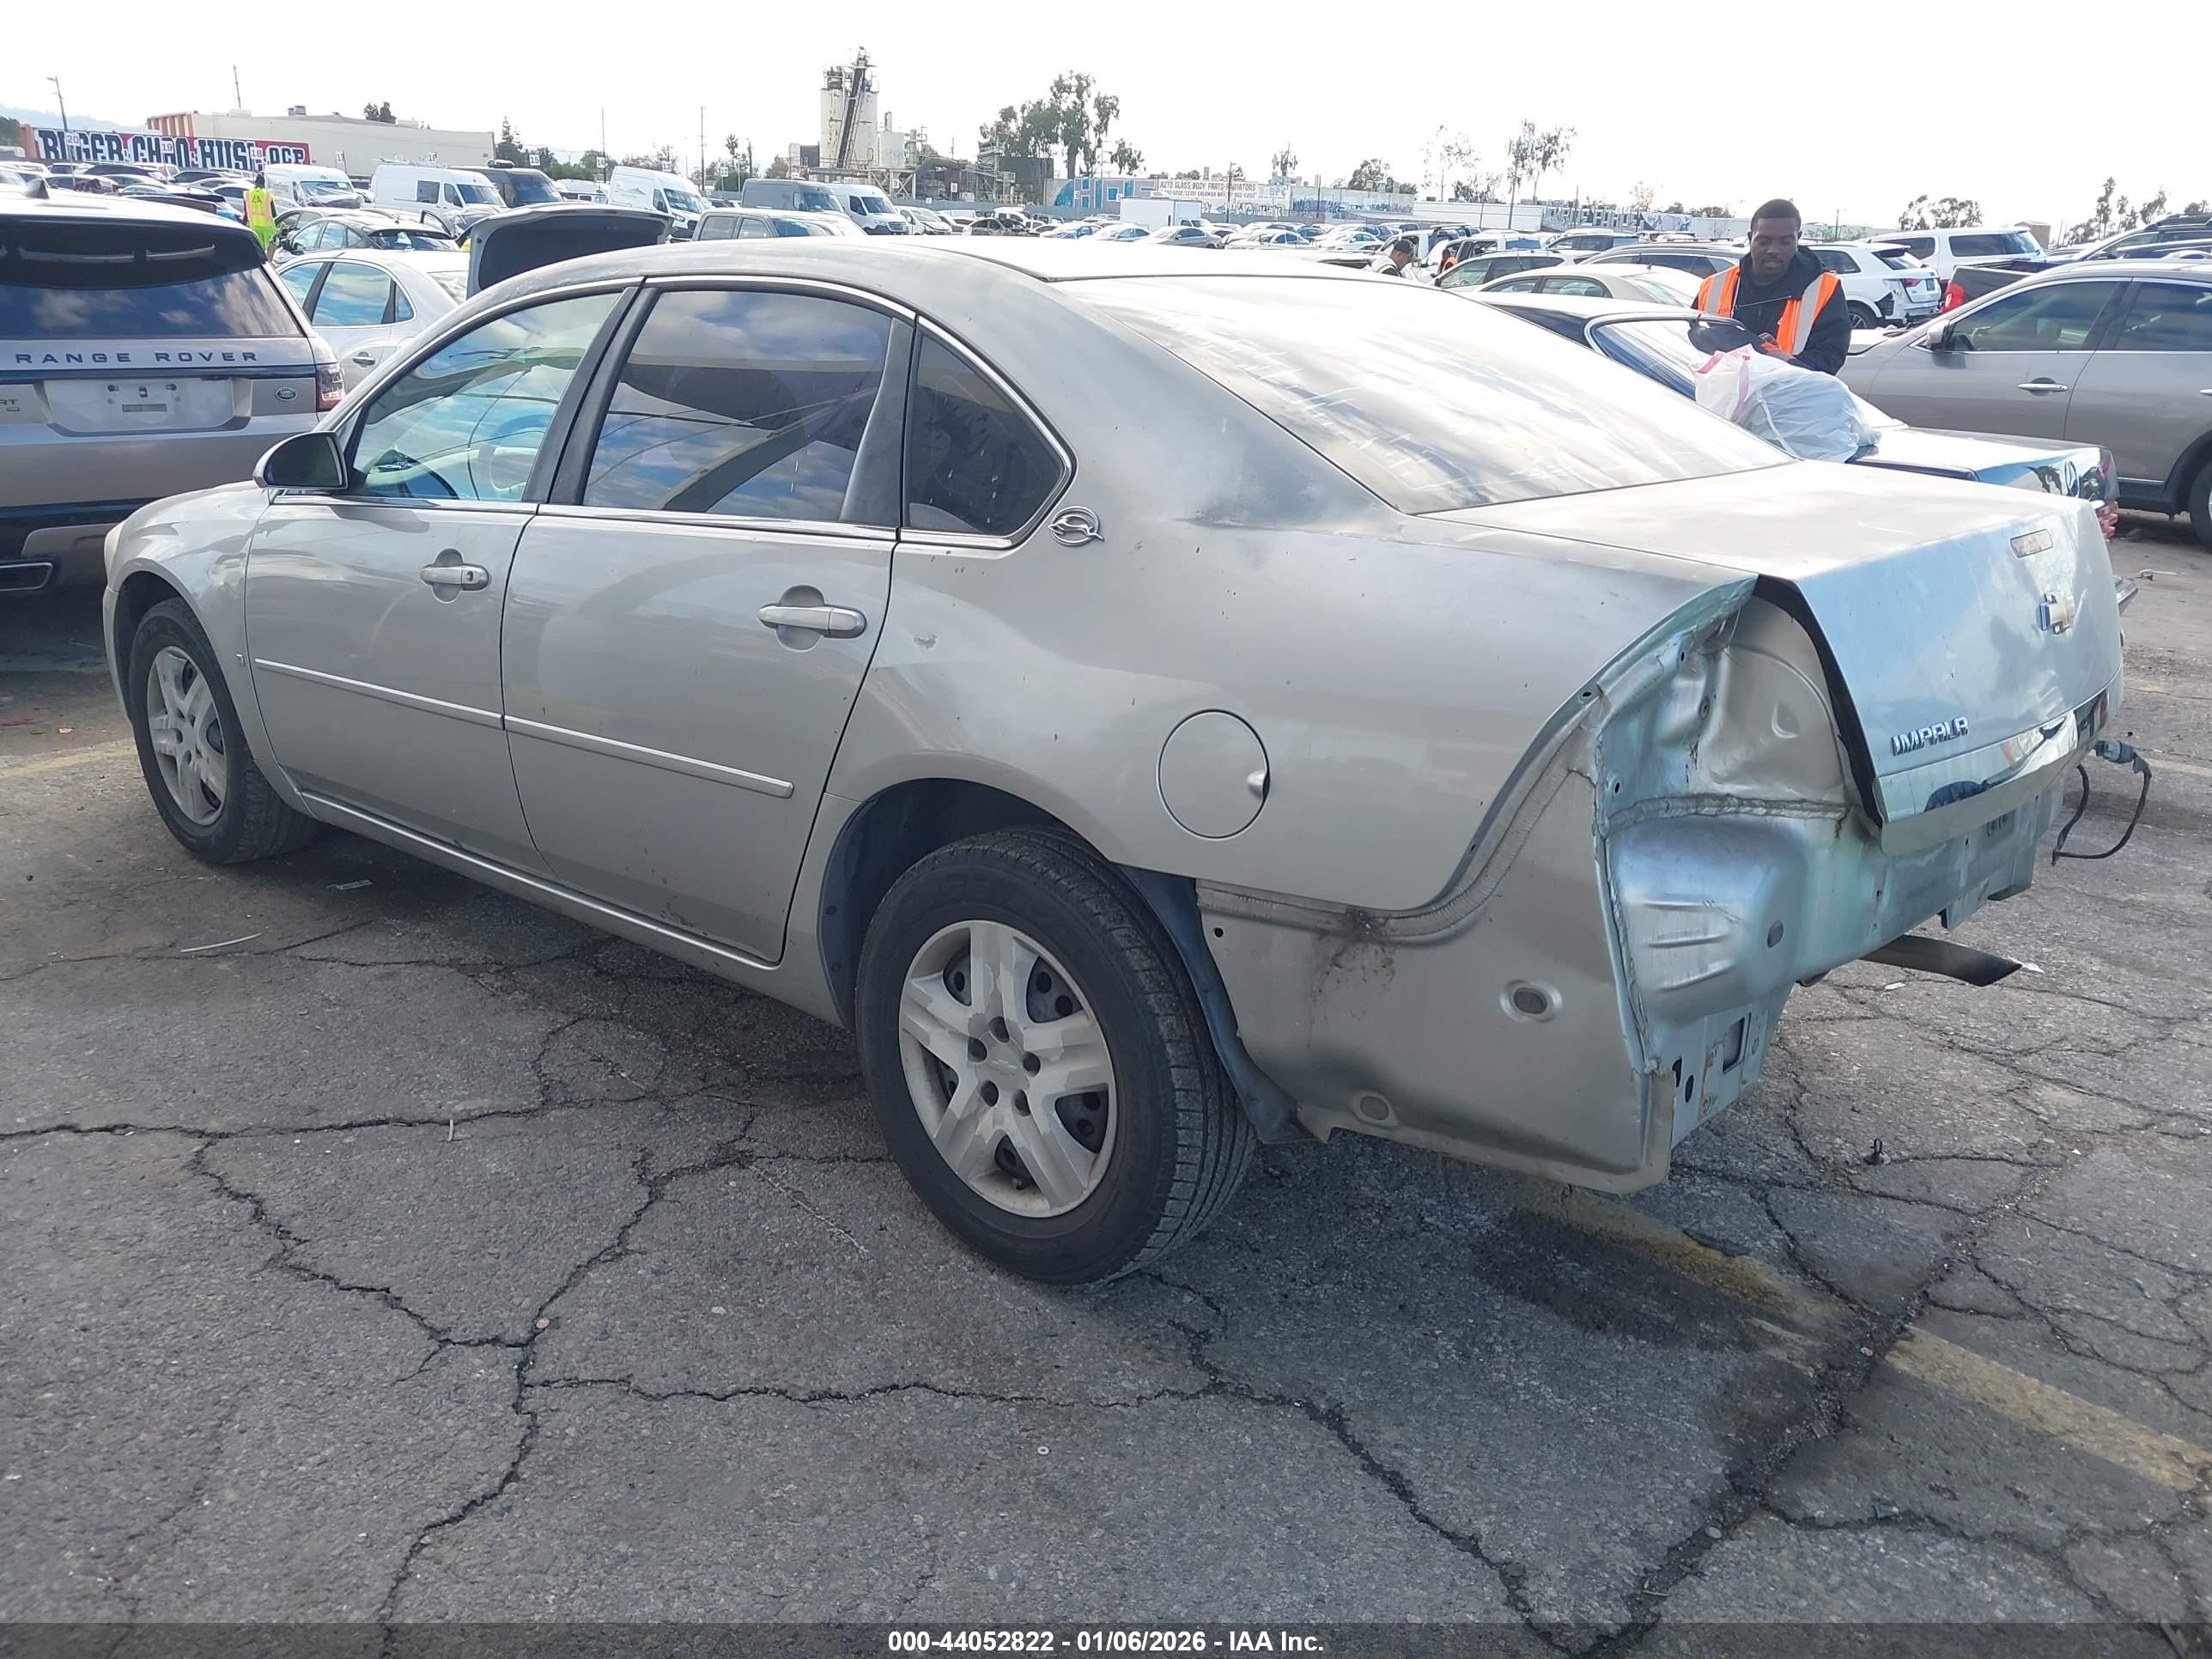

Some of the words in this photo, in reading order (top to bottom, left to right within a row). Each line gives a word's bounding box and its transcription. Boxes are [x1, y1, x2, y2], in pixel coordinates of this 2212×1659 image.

[67, 135, 79, 144] 20
[15, 352, 131, 364] RANGE
[155, 350, 258, 362] ROVER
[1892, 716, 1968, 756] IMPALA
